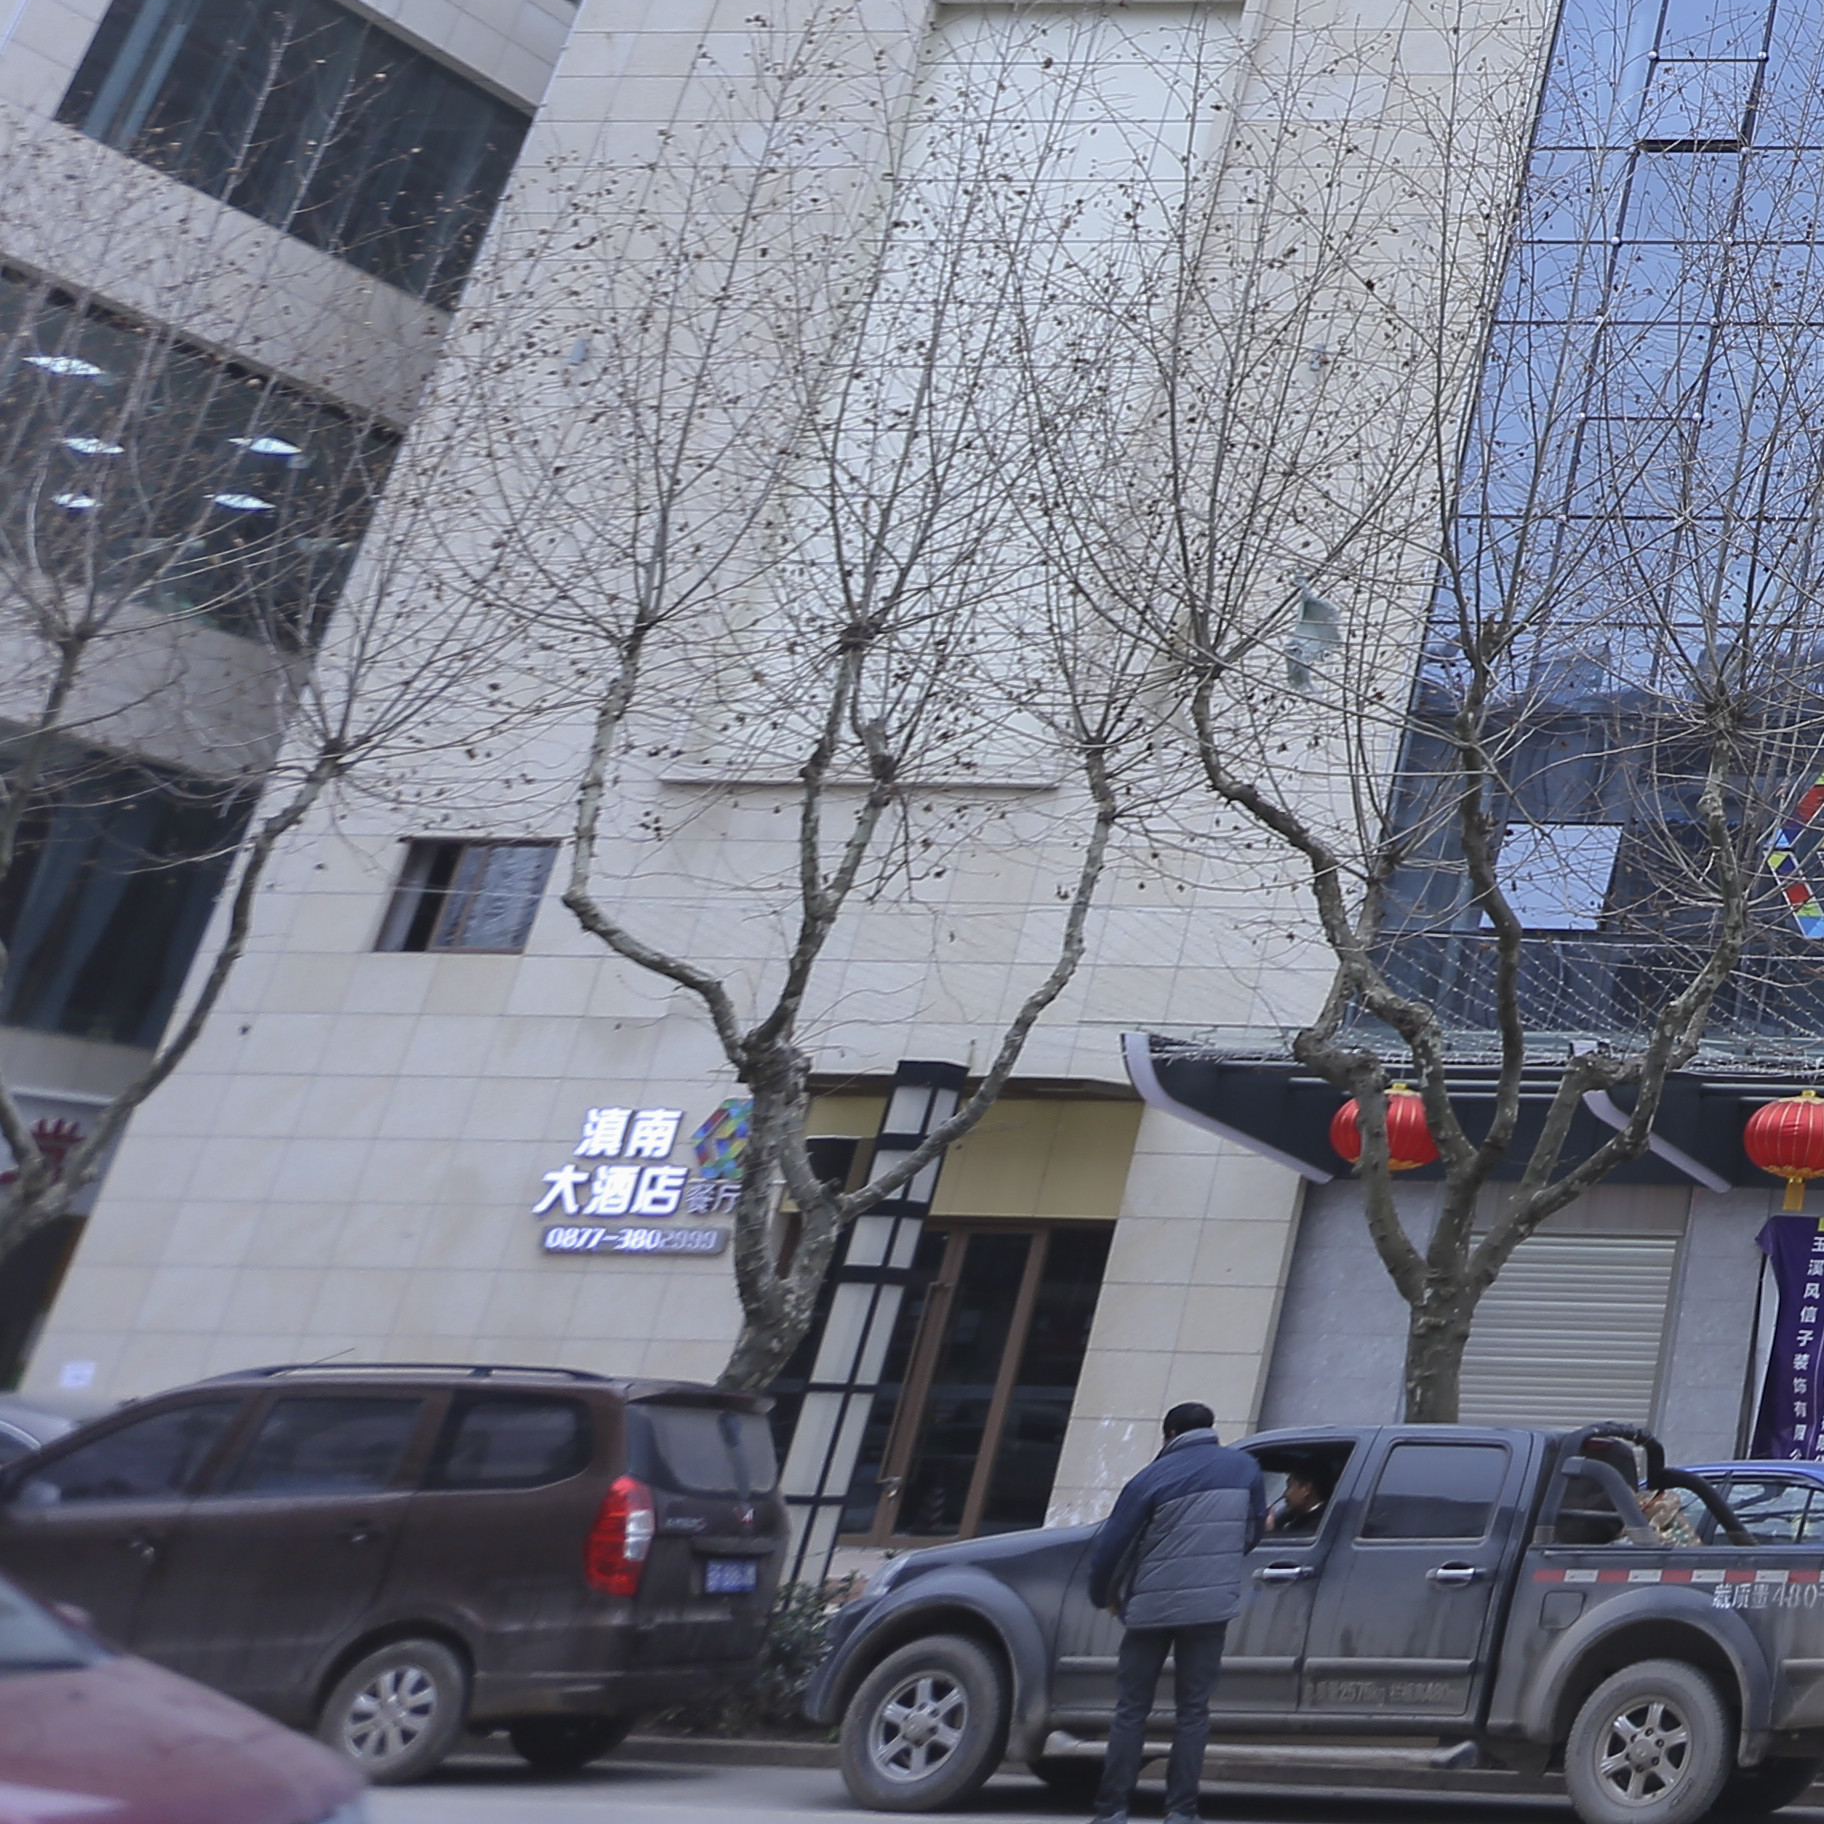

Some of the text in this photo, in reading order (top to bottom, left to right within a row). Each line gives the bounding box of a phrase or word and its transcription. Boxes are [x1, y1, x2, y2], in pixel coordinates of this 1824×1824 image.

[573, 1106, 684, 1159] 滇南
[531, 1163, 689, 1215] 大酒店
